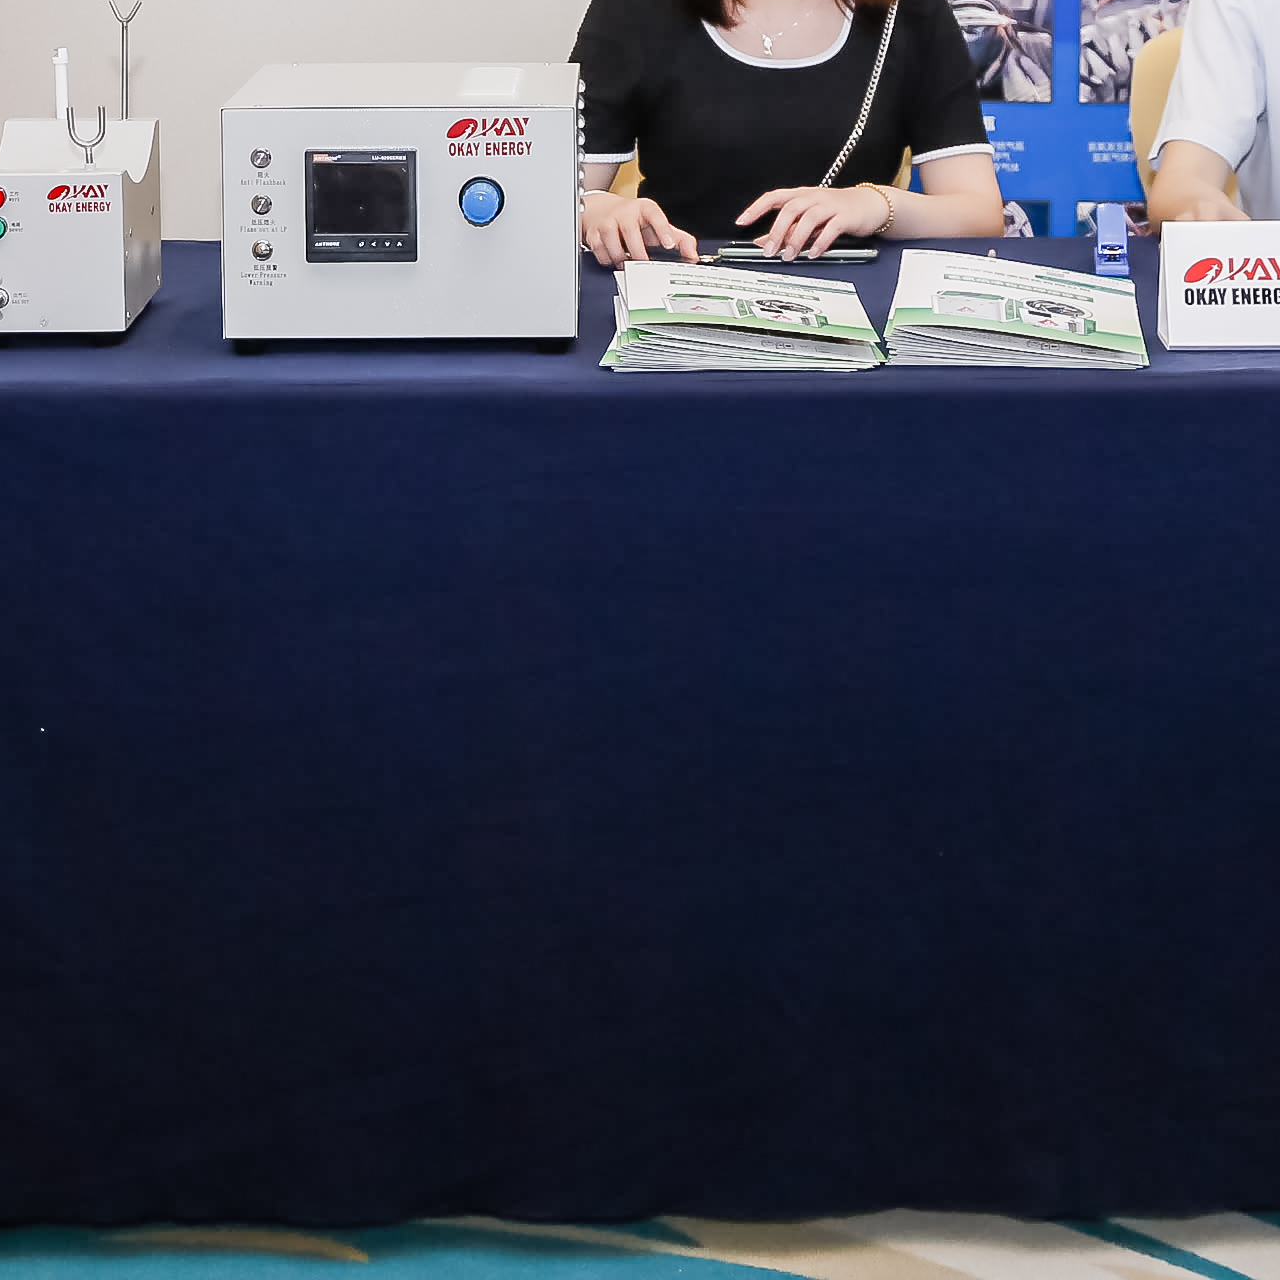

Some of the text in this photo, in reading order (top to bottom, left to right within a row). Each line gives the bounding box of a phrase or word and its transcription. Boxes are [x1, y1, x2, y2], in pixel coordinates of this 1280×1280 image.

[446, 118, 529, 140] OKAY
[448, 141, 532, 156] OKAY ENERGY
[47, 185, 109, 200] OKAY
[48, 201, 111, 212] OKAY ENERGY
[1184, 287, 1227, 305] OKAY
